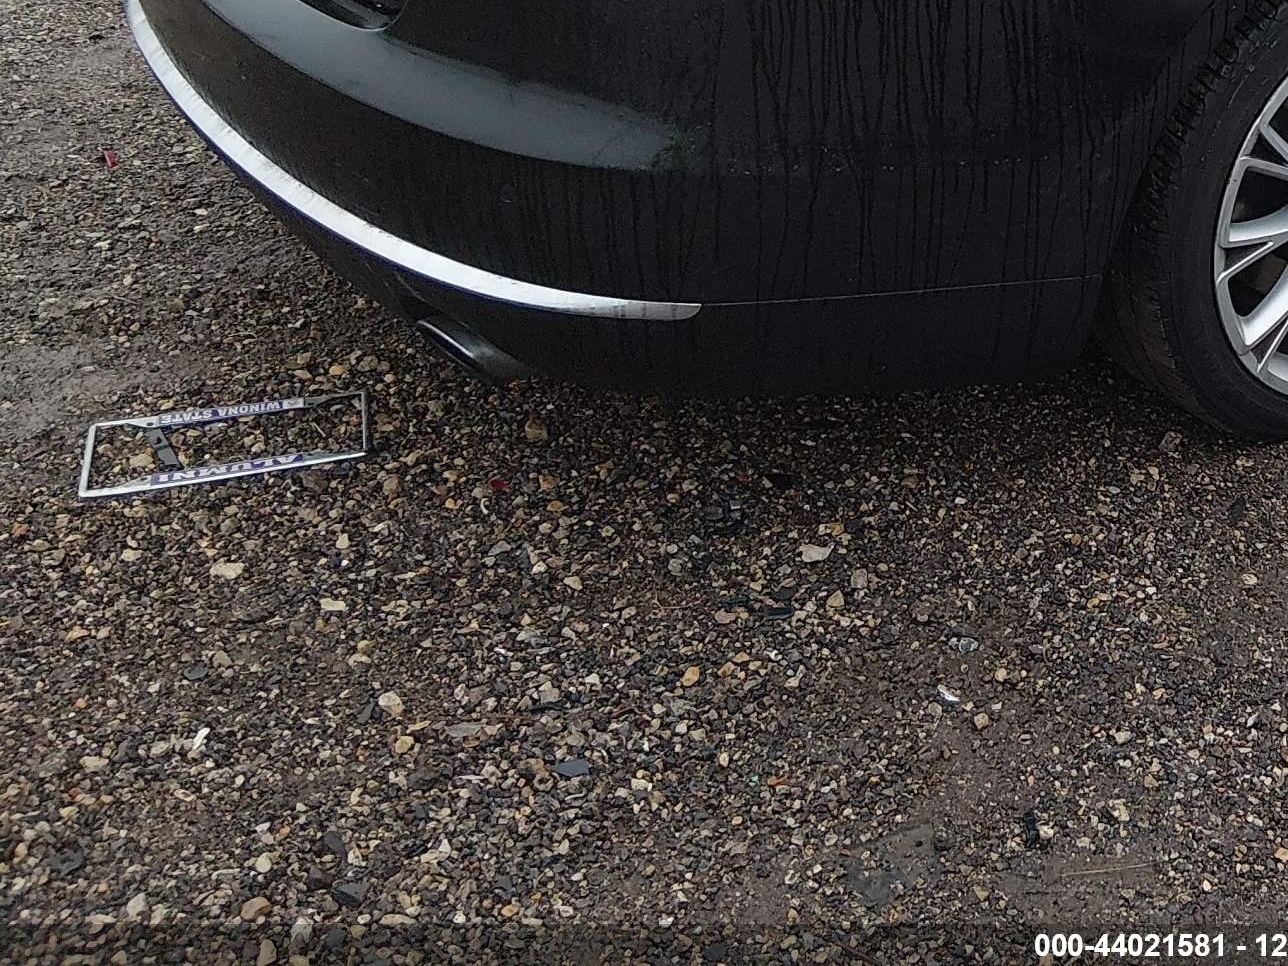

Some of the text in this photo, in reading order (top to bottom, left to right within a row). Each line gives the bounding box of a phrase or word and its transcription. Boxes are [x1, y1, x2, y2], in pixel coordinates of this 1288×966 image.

[160, 400, 281, 424] WINONA STATE
[158, 453, 302, 482] ALUMNI
